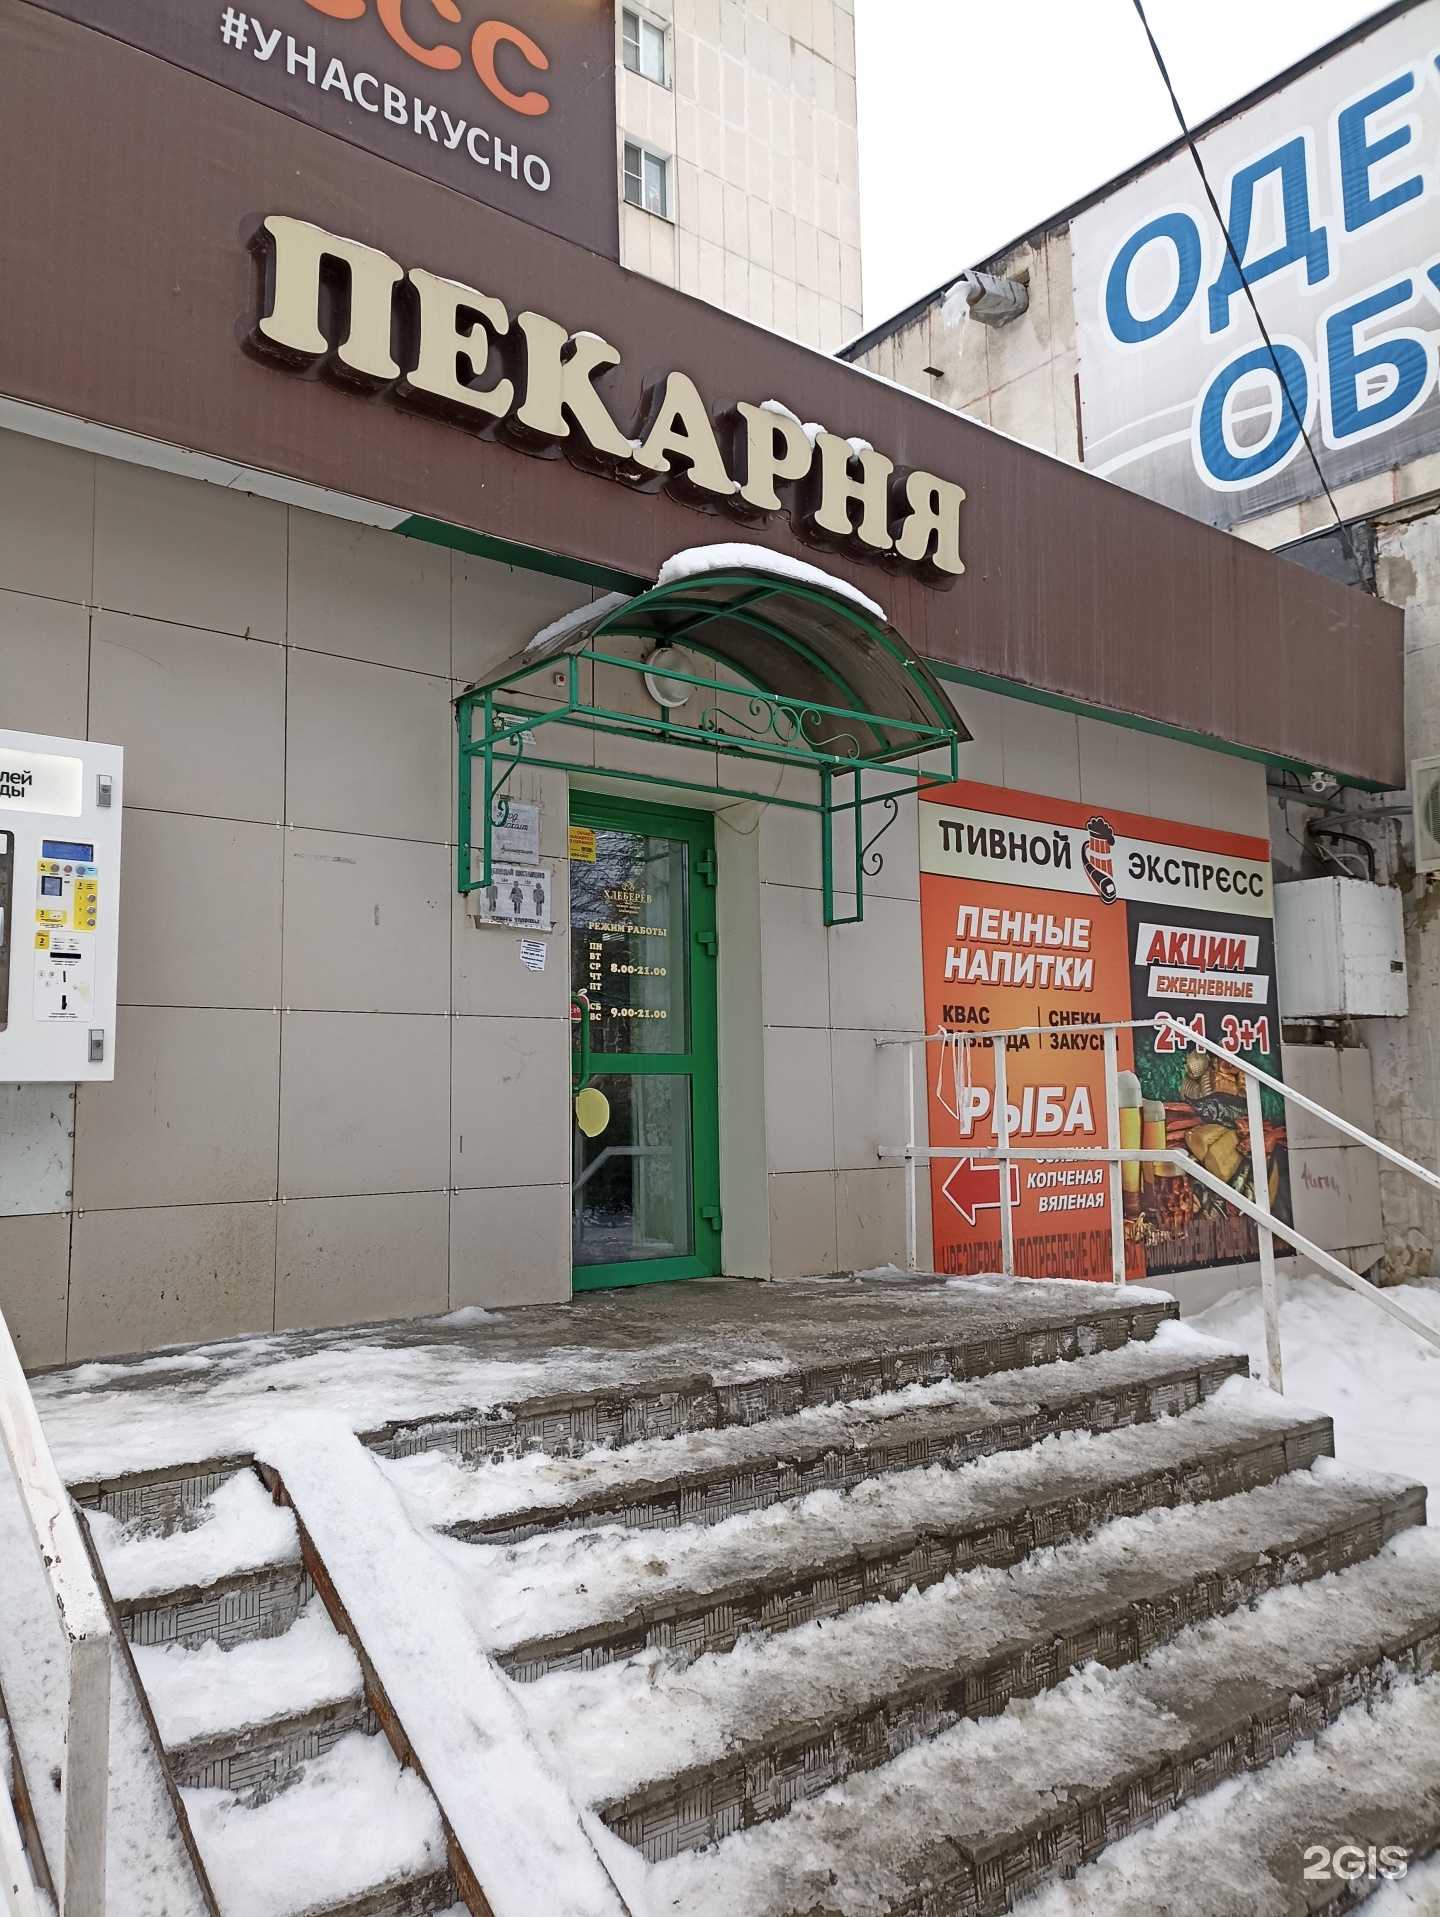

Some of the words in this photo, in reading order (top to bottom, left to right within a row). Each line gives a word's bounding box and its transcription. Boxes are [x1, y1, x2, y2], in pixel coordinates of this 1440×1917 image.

[303, 0, 550, 116] СС
[219, 7, 552, 192] #УНАСВКУСНО
[1104, 52, 1440, 344] ОДЕ
[1199, 258, 1440, 483] ОБ
[258, 214, 967, 577] ПЕКАРНЯ
[938, 819, 1072, 870] ПИВНОЙ
[1128, 852, 1264, 898] ЭКСПРЕСС
[588, 921, 626, 933] РЕЖИМ
[627, 925, 667, 937] РАБОТЫ
[955, 904, 1094, 951] ПЕННЫЕ
[589, 942, 603, 951] ПН
[589, 952, 602, 961] ВТ
[1146, 929, 1247, 974] АКЦИИ
[589, 962, 602, 971] СР
[610, 963, 667, 977] 8.00-21.00
[589, 973, 602, 981] ЧТ
[943, 946, 1095, 992] НАПИТКИ
[589, 982, 602, 991] ПТ
[1156, 974, 1254, 998] ЕЖЕДНЕВНЫЕ
[590, 1002, 602, 1011] СБ
[590, 1012, 602, 1021] ВС
[610, 1007, 667, 1019] 9.00-21.00
[942, 1004, 991, 1025] КВАС
[1048, 1010, 1102, 1028] СНЕКИ
[1049, 1032, 1119, 1051] ЗАКУС
[1220, 1014, 1270, 1055] 3+1
[959, 1086, 1096, 1138] РЫБА
[1026, 1168, 1104, 1189] КОПЧЕНАЯ
[1038, 1192, 1105, 1213] ВЯЛЕНАЯ
